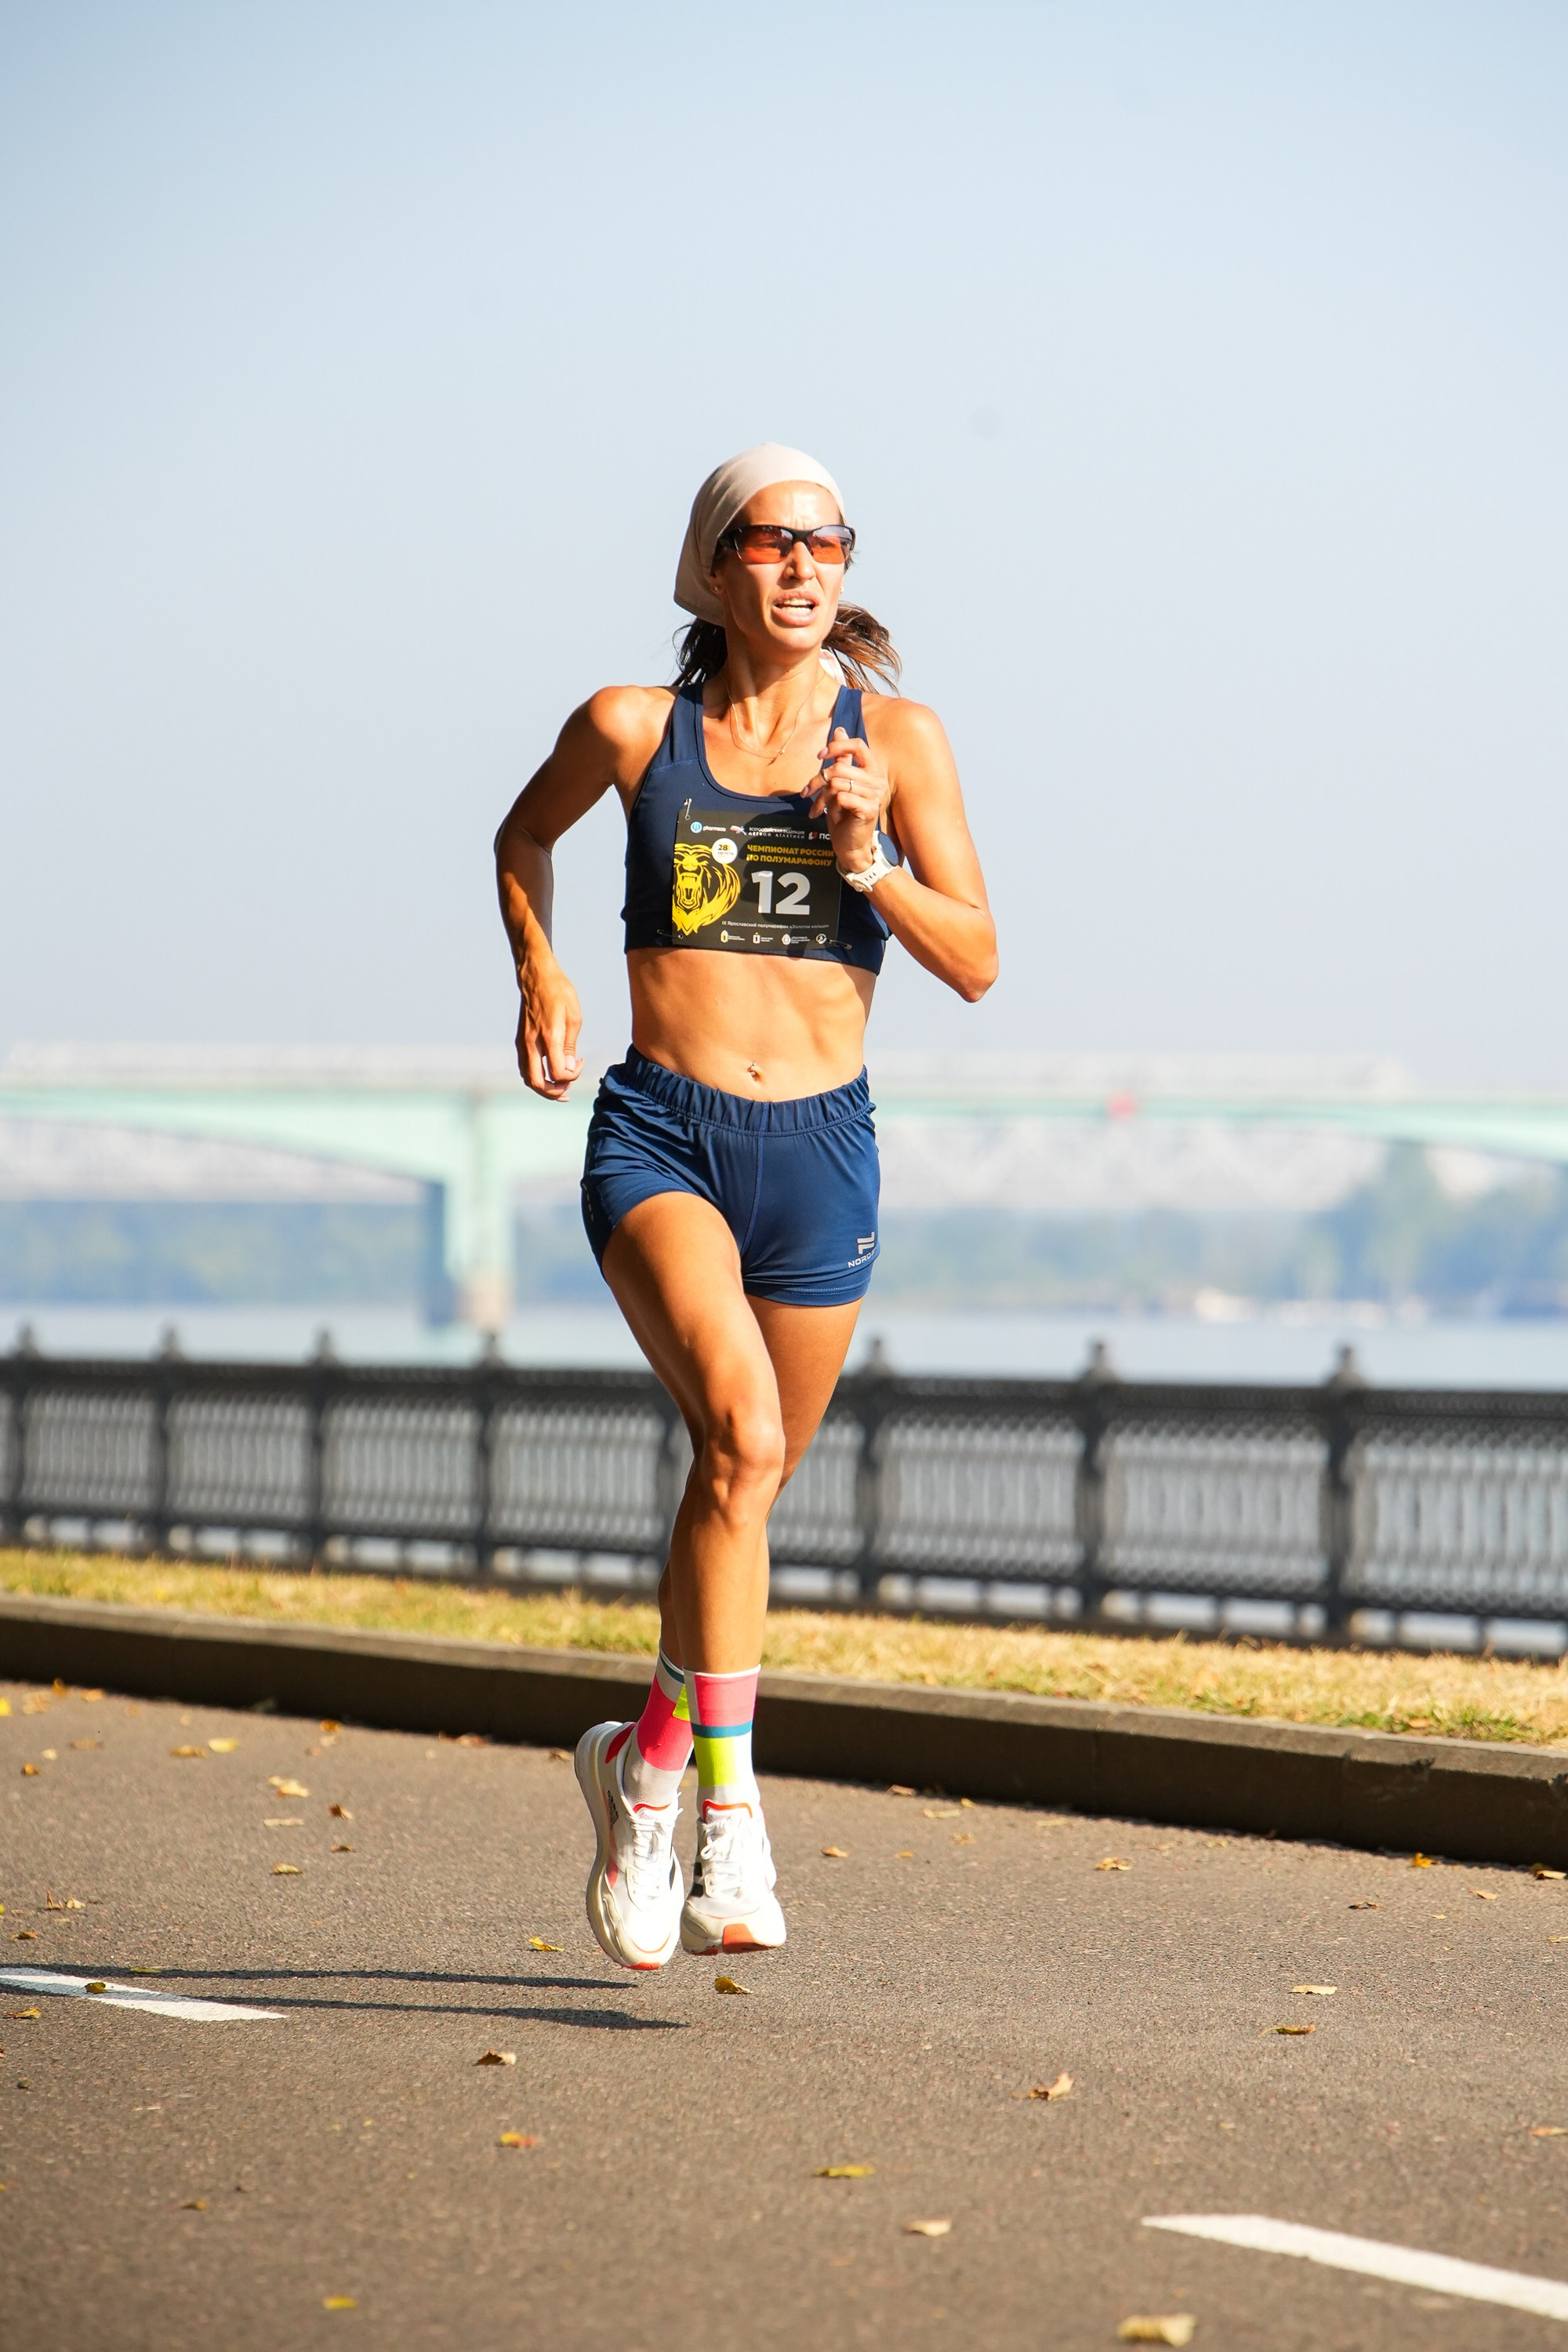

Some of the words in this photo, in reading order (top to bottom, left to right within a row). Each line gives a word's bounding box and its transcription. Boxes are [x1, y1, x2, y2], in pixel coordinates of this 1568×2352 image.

[747, 844, 799, 855] ЧЕМПИОНАТ
[800, 848, 834, 857] РОССИИ
[760, 855, 833, 866] ПОЛУМАРАФОНУ
[750, 870, 811, 916] 12
